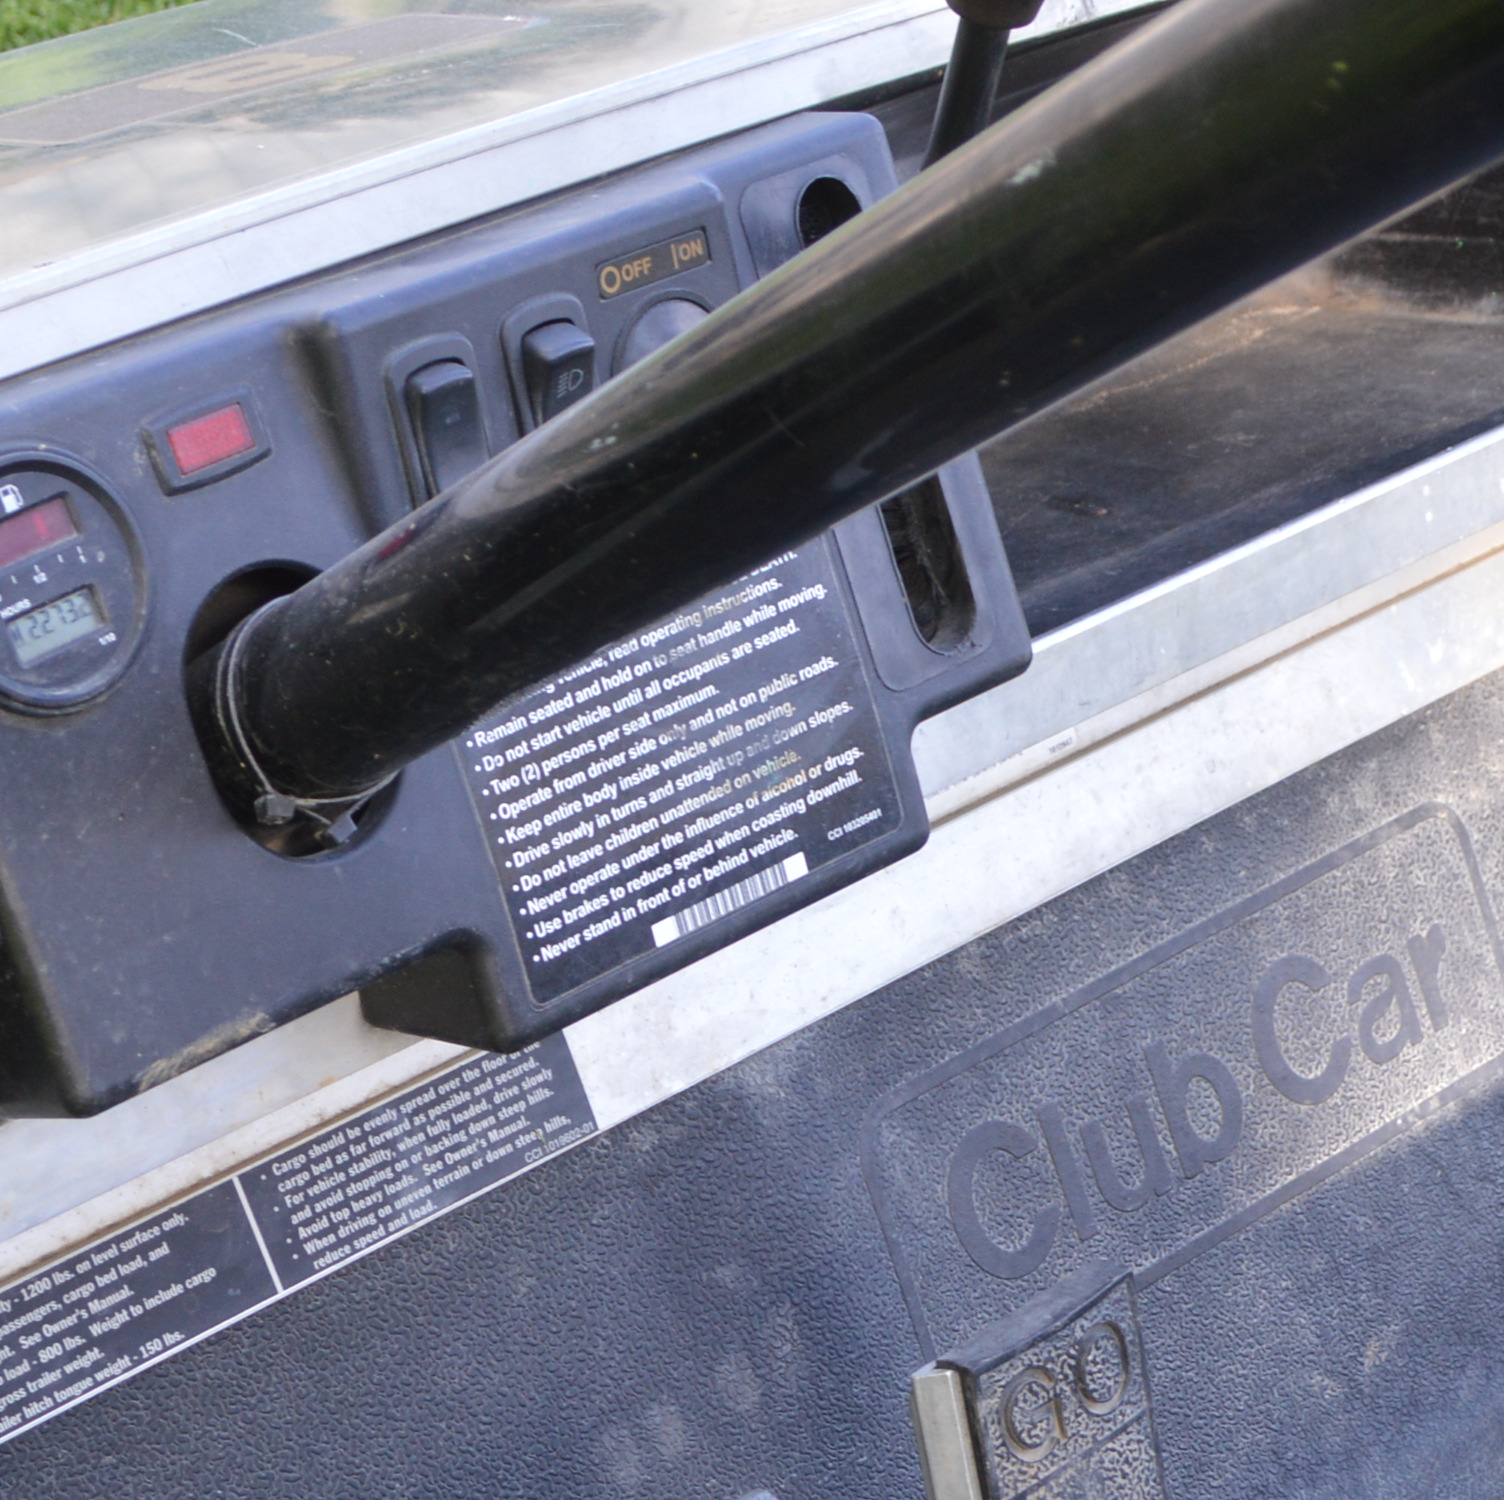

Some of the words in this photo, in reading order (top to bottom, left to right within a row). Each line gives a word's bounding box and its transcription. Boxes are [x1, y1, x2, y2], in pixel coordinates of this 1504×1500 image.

[0, 598, 32, 619] HOURS
[473, 715, 528, 748] Remain
[527, 690, 575, 724] seated
[573, 678, 602, 704] and
[599, 664, 634, 691] hold
[632, 659, 653, 677] on
[651, 653, 668, 668] to
[668, 636, 698, 660] seat
[696, 619, 743, 648] handle
[741, 603, 777, 628] while
[776, 582, 828, 613] moving.
[606, 637, 640, 662] read
[639, 610, 702, 648] operating
[701, 577, 783, 618] instructions.
[481, 753, 505, 772] Do
[504, 739, 531, 762] not
[529, 724, 564, 751] start
[561, 704, 612, 735] vehicle
[611, 686, 644, 714] until
[643, 678, 662, 699] all
[661, 651, 731, 691] occupants
[730, 641, 753, 660] are
[752, 617, 800, 650] seated.
[488, 773, 521, 795] Two
[519, 761, 541, 785] (2)
[540, 738, 597, 777] persons
[596, 726, 620, 751] per
[620, 710, 653, 736] seat
[650, 683, 720, 722] maximum.
[504, 818, 543, 844] Keep
[542, 799, 583, 827] entire
[581, 781, 618, 808] body
[616, 762, 660, 791] inside
[659, 740, 708, 771] vehicle
[707, 723, 744, 748] while
[743, 701, 796, 732] moving.
[518, 873, 542, 892] Do
[541, 858, 568, 882] not
[565, 843, 604, 870] leave
[603, 816, 660, 851] children
[658, 777, 732, 825] unattended
[732, 772, 752, 789] on
[751, 749, 802, 779] vehicle.
[525, 885, 568, 916] Never
[568, 861, 621, 895] operate
[620, 840, 660, 870] under
[659, 830, 684, 850] the
[682, 801, 745, 839] influence
[744, 790, 760, 809] of
[760, 768, 808, 802] alcohol
[807, 763, 822, 779] or
[822, 745, 865, 772] drugs.
[532, 916, 563, 938] Use
[560, 893, 610, 925] brakes
[608, 885, 626, 901] to
[625, 862, 673, 894] reduce
[672, 838, 715, 871] speed
[713, 824, 751, 850] when
[750, 797, 807, 832] coasting
[805, 768, 863, 805] downhill.
[539, 932, 581, 962] Never
[581, 909, 622, 941] stand
[620, 905, 638, 922] in
[635, 886, 672, 914] front
[670, 877, 686, 897] of
[686, 872, 702, 889] or
[701, 847, 750, 882] behind
[747, 827, 799, 858] vehicle.
[276, 1170, 311, 1193] cargo
[309, 1155, 334, 1176] bed
[333, 1150, 350, 1165] as
[348, 1141, 367, 1157] far
[367, 1116, 412, 1148] forward
[411, 1112, 427, 1126] as
[426, 1089, 472, 1121] possible
[472, 1076, 494, 1096] and
[493, 1055, 540, 1086] secured.
[283, 1190, 305, 1208] For
[305, 1170, 347, 1197] vehicle
[346, 1147, 397, 1177] stability,
[395, 1131, 426, 1152] when
[425, 1118, 451, 1137] fully
[450, 1097, 492, 1125] loaded,
[492, 1084, 520, 1105] drive
[520, 1067, 553, 1091] slowly
[523, 1146, 543, 1163] CCI
[948, 1038, 1243, 1279] Club
[1251, 922, 1449, 1105] Car
[19, 1276, 52, 1302] 1200
[50, 1269, 76, 1286] lbs.
[74, 1259, 92, 1274] on
[89, 1242, 120, 1266] level
[118, 1224, 161, 1253] surface
[160, 1212, 190, 1231] only.
[61, 1281, 96, 1304] cargo
[93, 1266, 119, 1288] bed
[116, 1253, 148, 1276] load,
[147, 1240, 170, 1262] and
[312, 1243, 352, 1270] reduce
[352, 1223, 386, 1250] speed
[386, 1211, 409, 1232] and
[407, 1198, 438, 1220] load.
[17, 1331, 42, 1350] See
[41, 1307, 89, 1338] Owner's
[86, 1283, 135, 1315] Manual.
[21, 1394, 54, 1419] hitch
[52, 1375, 94, 1403] tongue
[92, 1353, 133, 1382] weight
[138, 1337, 163, 1359] 150
[161, 1330, 186, 1347] lbs.
[25, 1367, 62, 1393] trailer
[62, 1346, 105, 1374] weight.
[1002, 1322, 1130, 1463] GO
